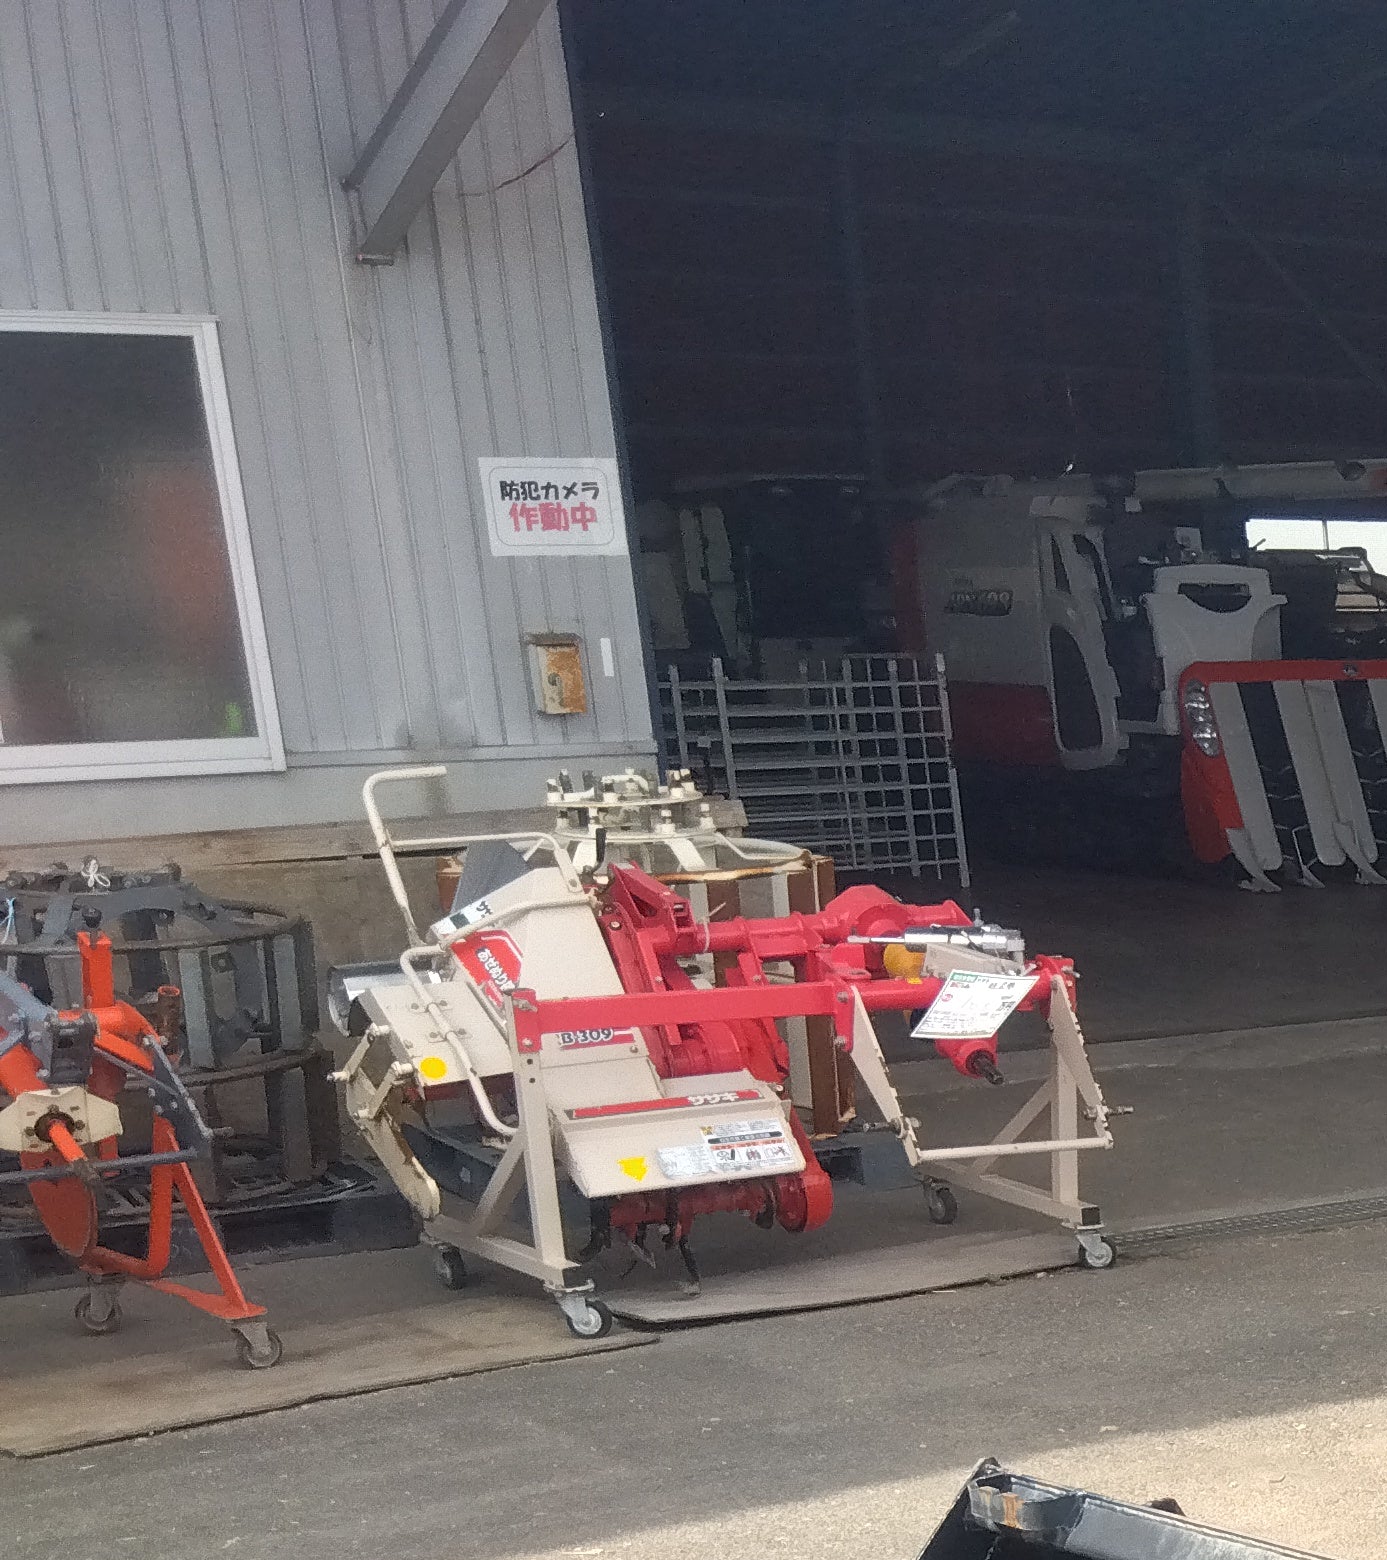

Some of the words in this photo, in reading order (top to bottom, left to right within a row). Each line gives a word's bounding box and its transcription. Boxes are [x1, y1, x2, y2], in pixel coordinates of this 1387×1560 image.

[499, 480, 600, 501] 防犯カメラ
[508, 501, 598, 532] 作動中
[688, 1093, 739, 1106] ササキ
